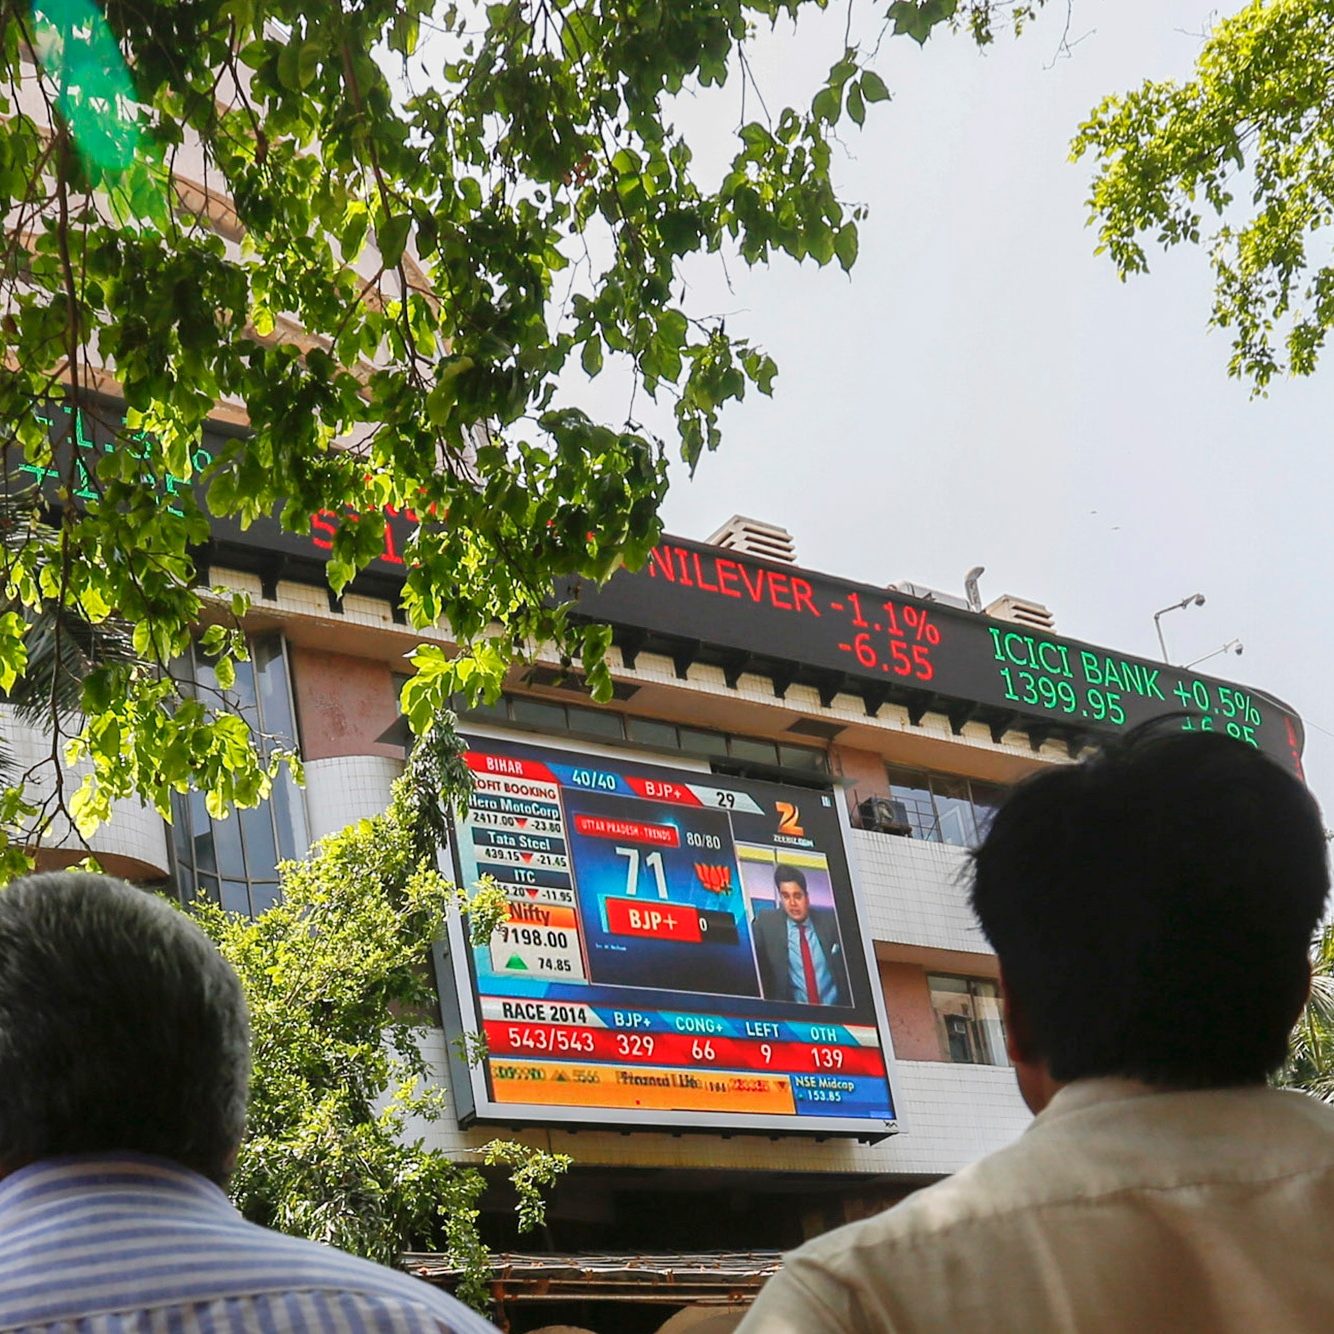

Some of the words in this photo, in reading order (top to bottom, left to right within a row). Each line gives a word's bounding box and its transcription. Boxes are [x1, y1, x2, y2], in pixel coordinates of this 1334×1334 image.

[646, 545, 822, 617] NILEVER
[830, 591, 942, 645] -1.1%
[838, 632, 935, 681] -6.55
[988, 626, 1075, 679] ICICI
[1080, 650, 1166, 701] BANK
[1173, 679, 1262, 726] +0.5%
[999, 667, 1127, 725] 1399.95
[486, 756, 524, 774] BIHAR
[475, 779, 502, 792] OFIT
[504, 781, 557, 800] BOOKING
[572, 769, 616, 790] 40/40
[644, 781, 682, 799] BJP+
[716, 791, 736, 809] 29
[469, 793, 498, 811] Hero
[500, 797, 560, 820] MotoCorp
[473, 811, 515, 827] 2417.00
[581, 818, 606, 832] UTTAR
[487, 831, 515, 846] Tata
[518, 834, 551, 851] Steel
[686, 831, 721, 850] 80/80
[485, 847, 520, 862] 439.15
[536, 854, 567, 867] -21.45
[514, 869, 536, 884] ITC
[615, 846, 669, 900] 71
[542, 889, 573, 903] -11.95
[508, 902, 550, 927] Nifty
[628, 908, 678, 931] BJP+
[699, 916, 708, 932] 0
[499, 926, 568, 949] 7198.00
[538, 957, 572, 972] 74.85
[502, 1001, 547, 1021] RACE
[550, 1005, 587, 1024] 2014
[613, 1011, 652, 1028] BJP+
[675, 1016, 723, 1033] CONG+
[745, 1021, 780, 1038] LEFT
[810, 1026, 838, 1042] OTH
[508, 1027, 595, 1052] 543/543
[616, 1033, 655, 1057] 329
[691, 1039, 716, 1061] 66
[760, 1044, 772, 1064] 9
[811, 1047, 843, 1068] 139
[795, 1076, 817, 1088] NSE
[818, 1078, 855, 1092] Midcap
[808, 1089, 842, 1102] 153.85
